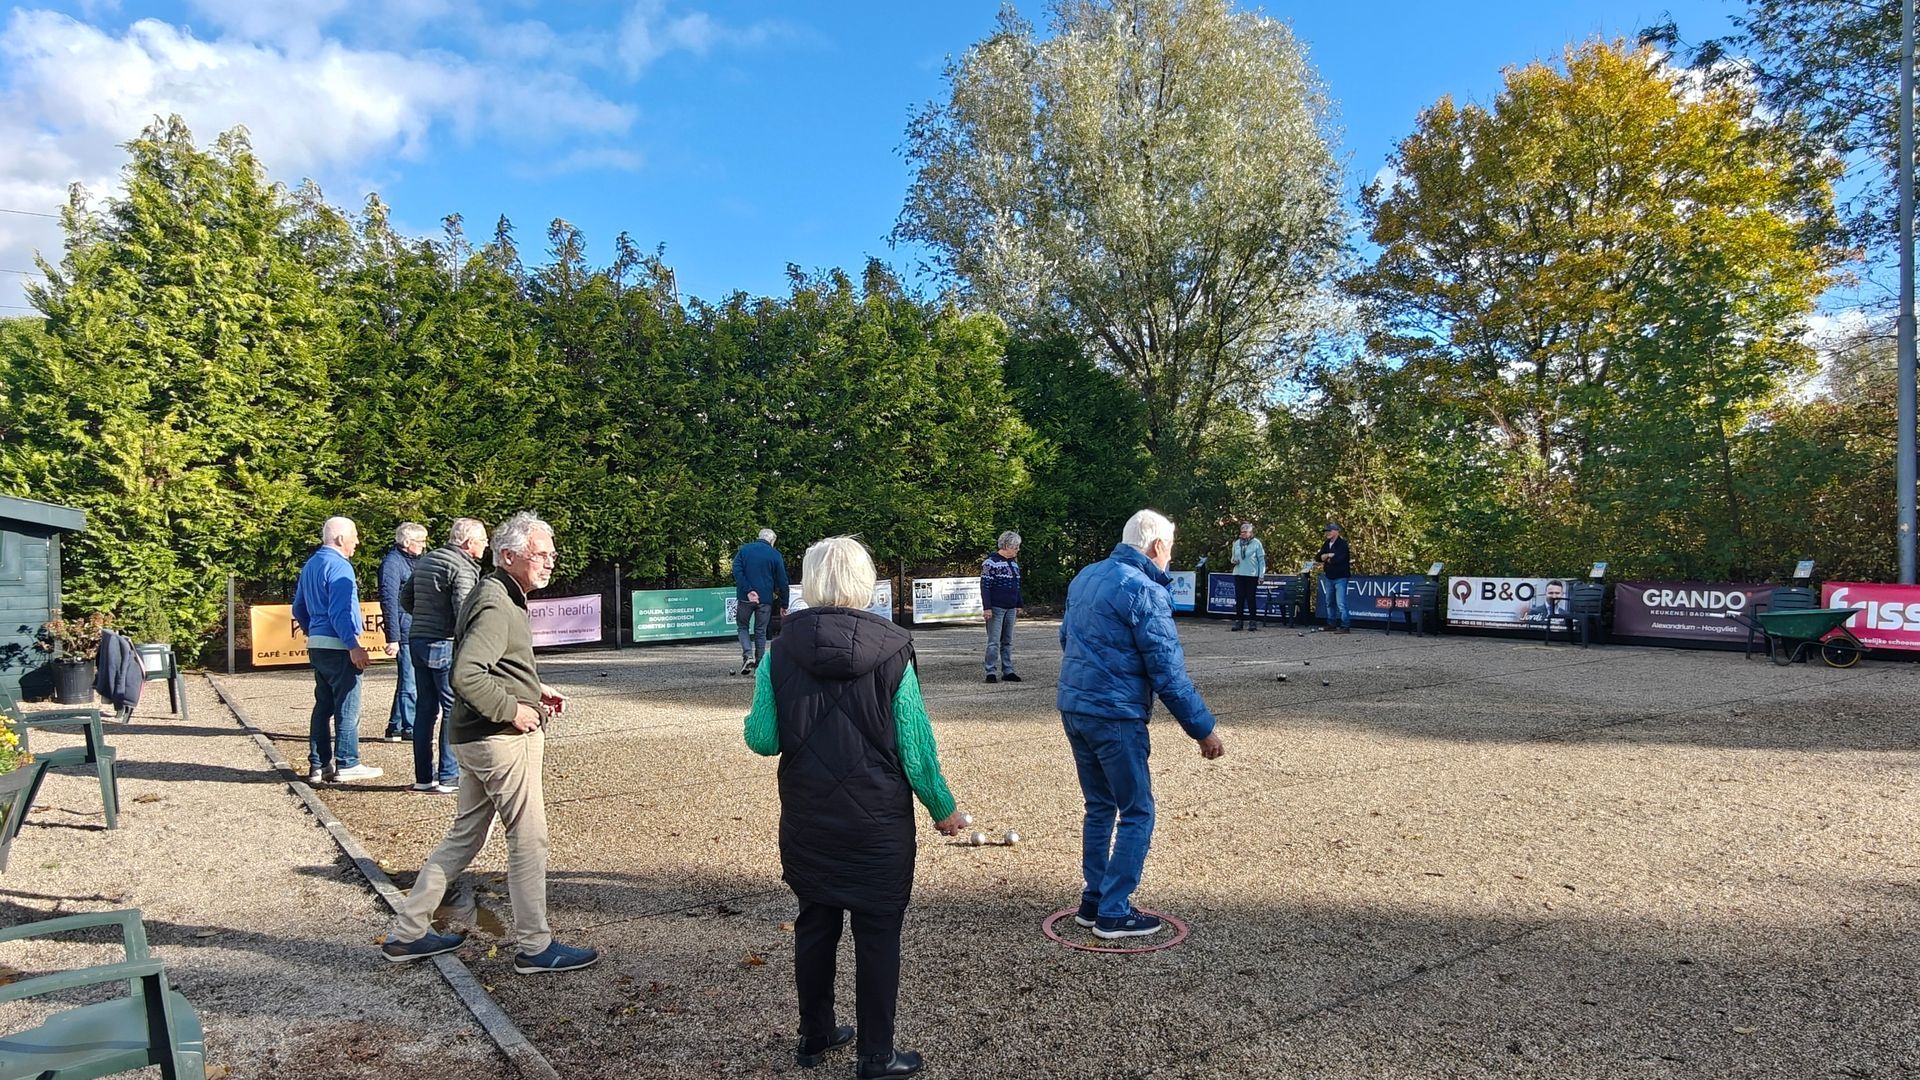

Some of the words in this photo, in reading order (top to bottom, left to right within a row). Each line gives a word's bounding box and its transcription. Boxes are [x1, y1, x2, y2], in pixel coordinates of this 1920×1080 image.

[1481, 582, 1535, 602] B&O
[1642, 589, 1746, 610] GRANDO
[558, 604, 594, 616] health
[1651, 622, 1696, 630] Alexandrium
[1702, 624, 1738, 633] Hoogvliet
[1859, 637, 1887, 645] akelijke
[257, 649, 280, 658] CAFÉ
